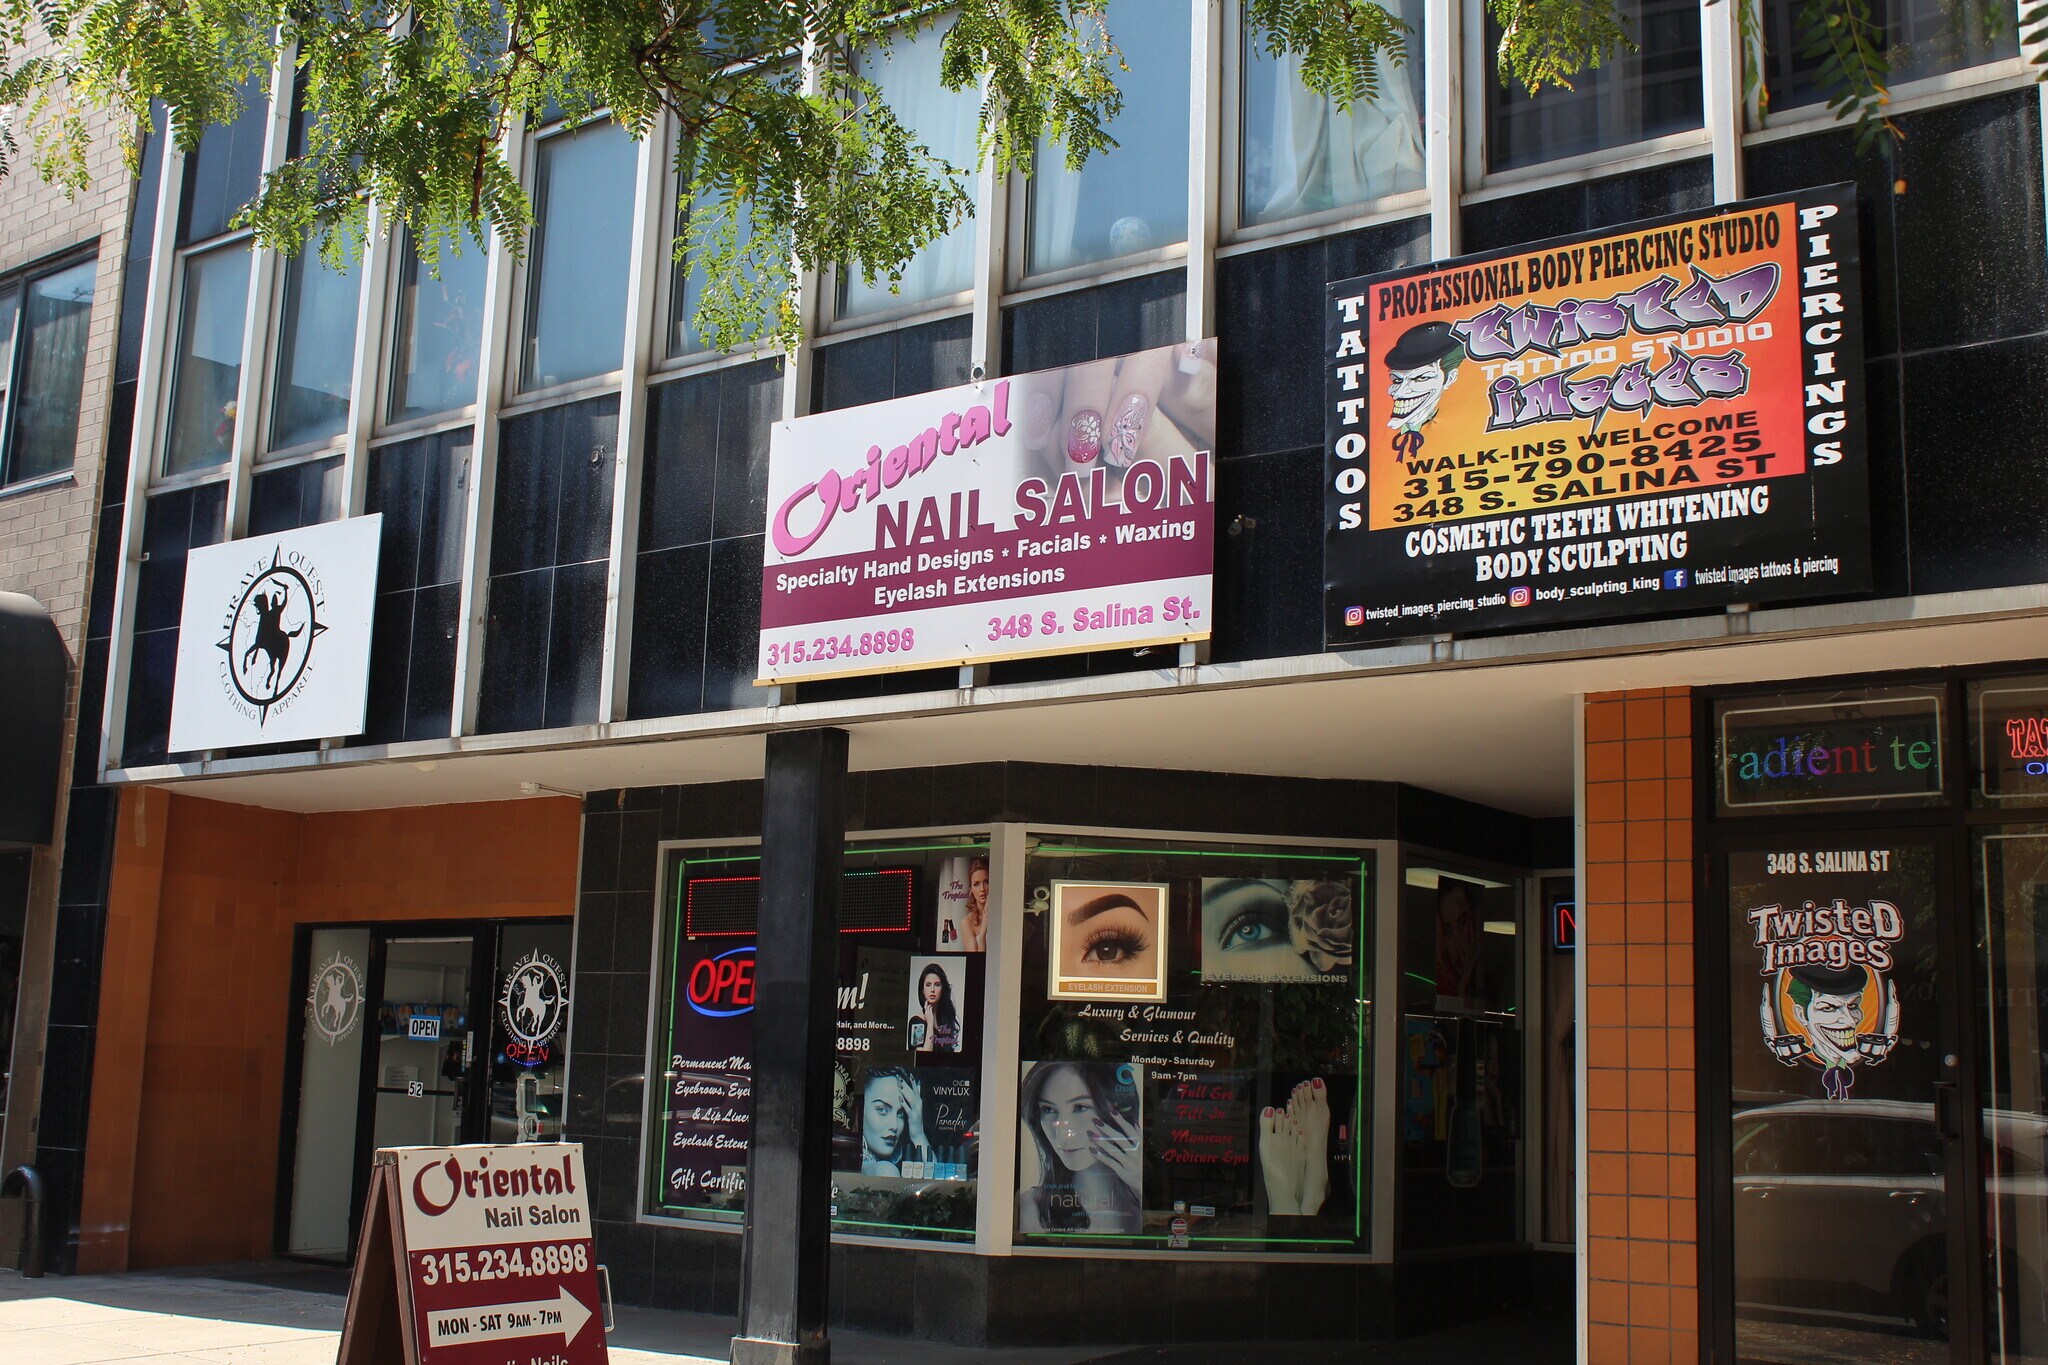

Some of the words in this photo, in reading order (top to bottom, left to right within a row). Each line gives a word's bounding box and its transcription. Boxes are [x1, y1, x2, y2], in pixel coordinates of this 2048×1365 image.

[1378, 265, 1524, 321] PROFESSIONAL
[1527, 251, 1583, 292] BODY
[1589, 227, 1693, 282] PIERCING
[1698, 211, 1780, 260] STUDIO
[1481, 346, 1618, 381] TATTOO
[1632, 322, 1773, 357] STUDIO
[1800, 205, 1846, 466] PIERCINGS
[1334, 296, 1366, 531] TATTOOS
[1407, 438, 1567, 476] WALK-INS
[1577, 411, 1758, 451] WELCOME
[771, 379, 1013, 557] Oriental
[1404, 431, 1761, 498] 315-790-8425
[875, 488, 996, 551] NAIL
[1013, 451, 1211, 532] SALON
[1393, 496, 1464, 524] 348
[1478, 488, 1516, 510] S.
[1533, 464, 1699, 504] SALINA
[1716, 453, 1776, 479] ST
[1405, 515, 1526, 559] COSMETIC
[1531, 502, 1611, 542] TEETH
[1615, 485, 1769, 530] WHITENING
[776, 564, 858, 593] Specialty
[864, 556, 911, 580] Hand
[917, 547, 994, 573] Designs
[1017, 531, 1091, 558] Facials
[1115, 519, 1195, 545] Waxing
[1476, 549, 1543, 582] BODY
[1548, 530, 1688, 574] SCULPTING
[1695, 567, 1726, 586] twisted
[1728, 564, 1758, 586] images
[1760, 561, 1792, 579] tattoos
[1794, 559, 1801, 574] &
[1804, 556, 1839, 577] piercing
[222, 556, 268, 631] BRAVE
[289, 550, 326, 613] QUEST
[874, 580, 948, 607] Eyelash
[953, 565, 1065, 596] Extensions
[1535, 575, 1660, 601] body_sculpting_king
[988, 614, 1032, 642] 348
[1040, 612, 1064, 635] S.
[1072, 601, 1154, 632] Salina
[1163, 595, 1200, 622] St.
[1366, 592, 1506, 622] twisted_images_piercing_studio
[767, 627, 915, 667] 315.234.8898
[219, 660, 257, 721] CLOTHING
[271, 660, 316, 717] APPAREL
[1889, 735, 1937, 771] te
[1767, 853, 1796, 874] 348
[1799, 853, 1812, 873] S.
[1815, 851, 1868, 873] SALINA
[1870, 851, 1889, 871] ST
[310, 958, 334, 994] BRAVE
[344, 956, 364, 992] QUEST
[502, 954, 531, 994] BRAVE
[542, 954, 568, 992] QUEST
[690, 959, 755, 1004] OPE
[836, 973, 869, 1011] m!
[1069, 983, 1103, 991] EYELASH
[412, 1020, 438, 1036] OPEN
[501, 1010, 528, 1048] CLOTHING
[534, 1019, 563, 1049] APPAREL
[1077, 1004, 1124, 1021] Luxury
[1128, 1006, 1139, 1019] &
[1144, 1006, 1196, 1021] Glamour
[506, 1043, 550, 1061] OPEN
[835, 1037, 870, 1051] 8898
[1119, 1029, 1170, 1044] Services
[1173, 1030, 1184, 1043] &
[1187, 1032, 1235, 1047] Quality
[672, 1054, 728, 1069] Permanent
[729, 1056, 751, 1070] Ma
[1132, 1055, 1168, 1065] Monday
[1173, 1057, 1215, 1067] Saturday
[1151, 1072, 1171, 1080] 9am
[1177, 1072, 1197, 1082] 7pm
[675, 1081, 725, 1097] Eyebrows,
[933, 1087, 970, 1095] VINYLUX
[692, 1107, 700, 1120] &
[701, 1108, 721, 1124] Lip
[722, 1109, 749, 1122] Line
[673, 1132, 713, 1148] Eyelash
[413, 1154, 577, 1216] Oriental
[671, 1168, 696, 1190] Gift
[700, 1170, 746, 1193] Certific
[1050, 1190, 1114, 1207] natural
[485, 1206, 523, 1228] Nail
[529, 1205, 580, 1224] Salon
[421, 1244, 588, 1286] 315.234.8898
[438, 1318, 469, 1336] MON
[480, 1315, 501, 1331] SAT
[508, 1314, 531, 1329] 9AM
[540, 1310, 562, 1325] 7PM
